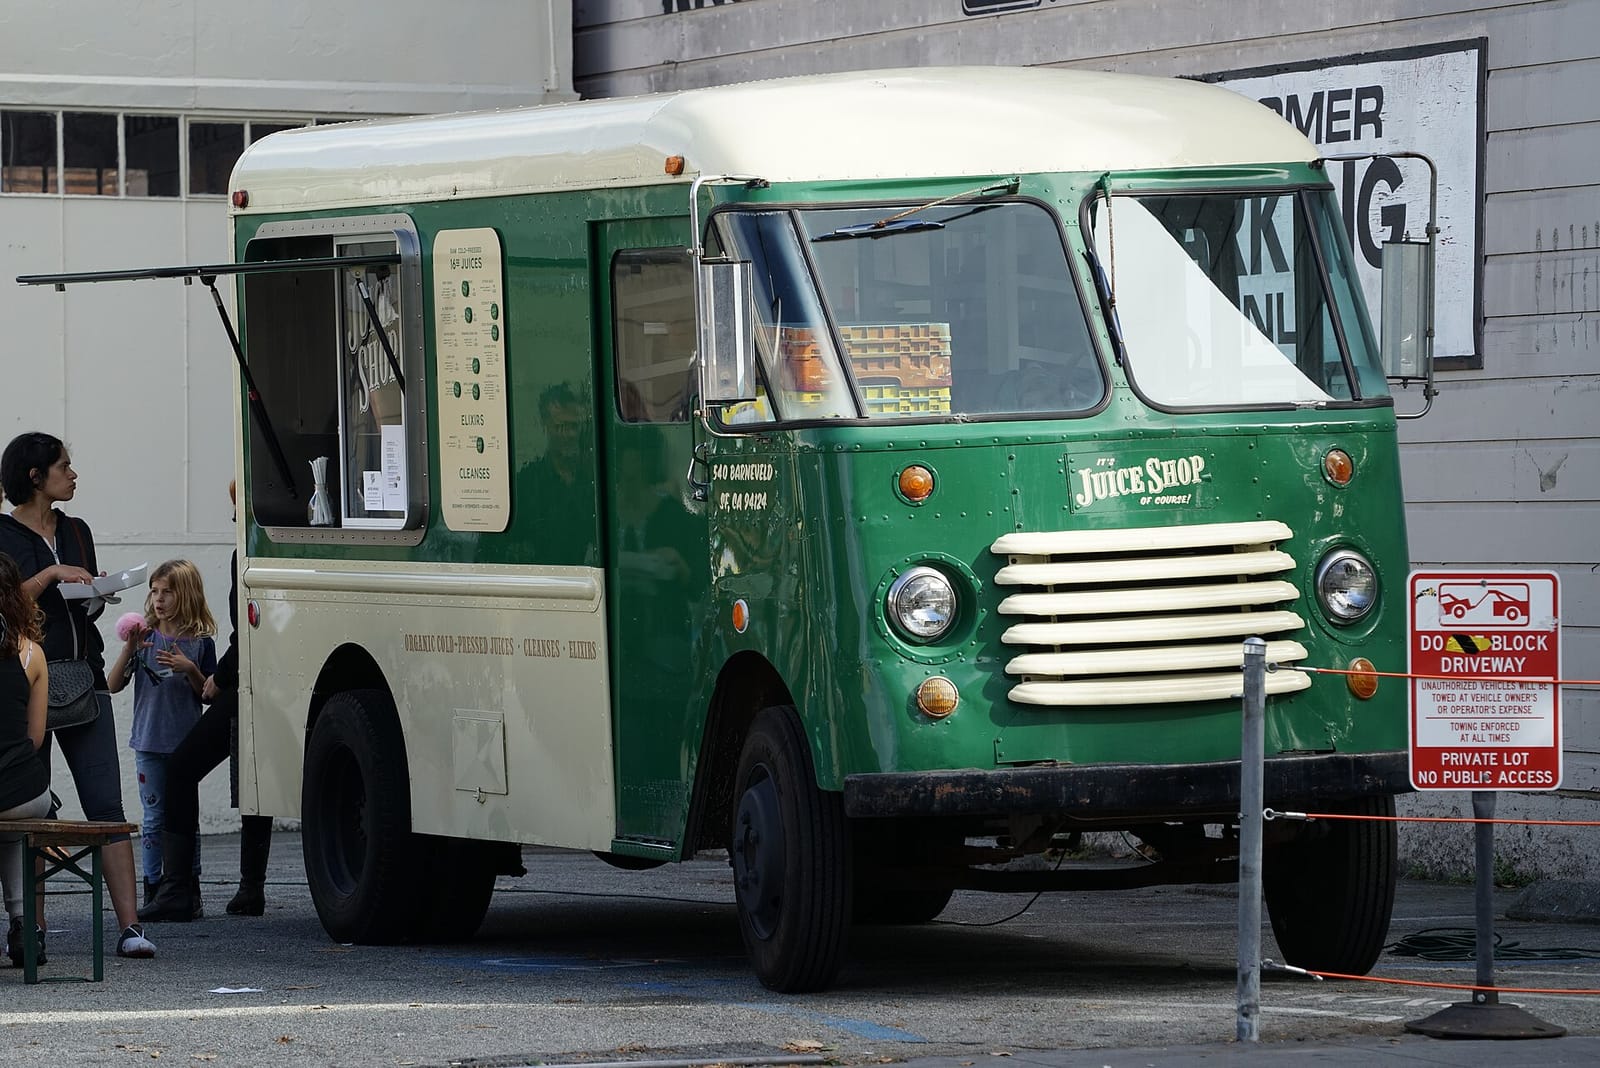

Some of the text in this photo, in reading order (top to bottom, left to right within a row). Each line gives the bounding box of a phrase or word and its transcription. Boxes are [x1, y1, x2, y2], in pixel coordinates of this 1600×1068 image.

[461, 256, 482, 269] JUICES
[461, 414, 485, 426] ELIXIRS
[1096, 458, 1116, 466] IT'S
[459, 467, 490, 480] CLEANSES
[713, 464, 773, 481] 540 BARNEVELD
[1076, 455, 1205, 506] JUICE SHOP
[732, 492, 742, 511] CA
[744, 492, 767, 511] 94124
[1140, 493, 1191, 505] OF COURSE!
[404, 634, 435, 652] ORGANIC
[490, 637, 514, 656] JUICES
[523, 638, 560, 658] CLEANSES
[568, 640, 597, 660] ELIXIRS
[1420, 635, 1444, 651] DO
[1491, 635, 1548, 651] BLOCK
[1441, 657, 1526, 673] DRIVEWAY
[1421, 681, 1548, 691] UNAUTHORIZED VEHICLES WILL BE
[1432, 693, 1538, 702] TOWED AT VEHICLE OWNER'S
[1437, 705, 1532, 714] OR OPERATOR'S EXPENSE
[1450, 722, 1520, 731] TOWING ENFORCED
[1460, 733, 1510, 742] AT ALL TIMES
[1441, 752, 1529, 766] PRIVATE LOT
[1418, 770, 1553, 784] NO PUBLIC ACCESS
